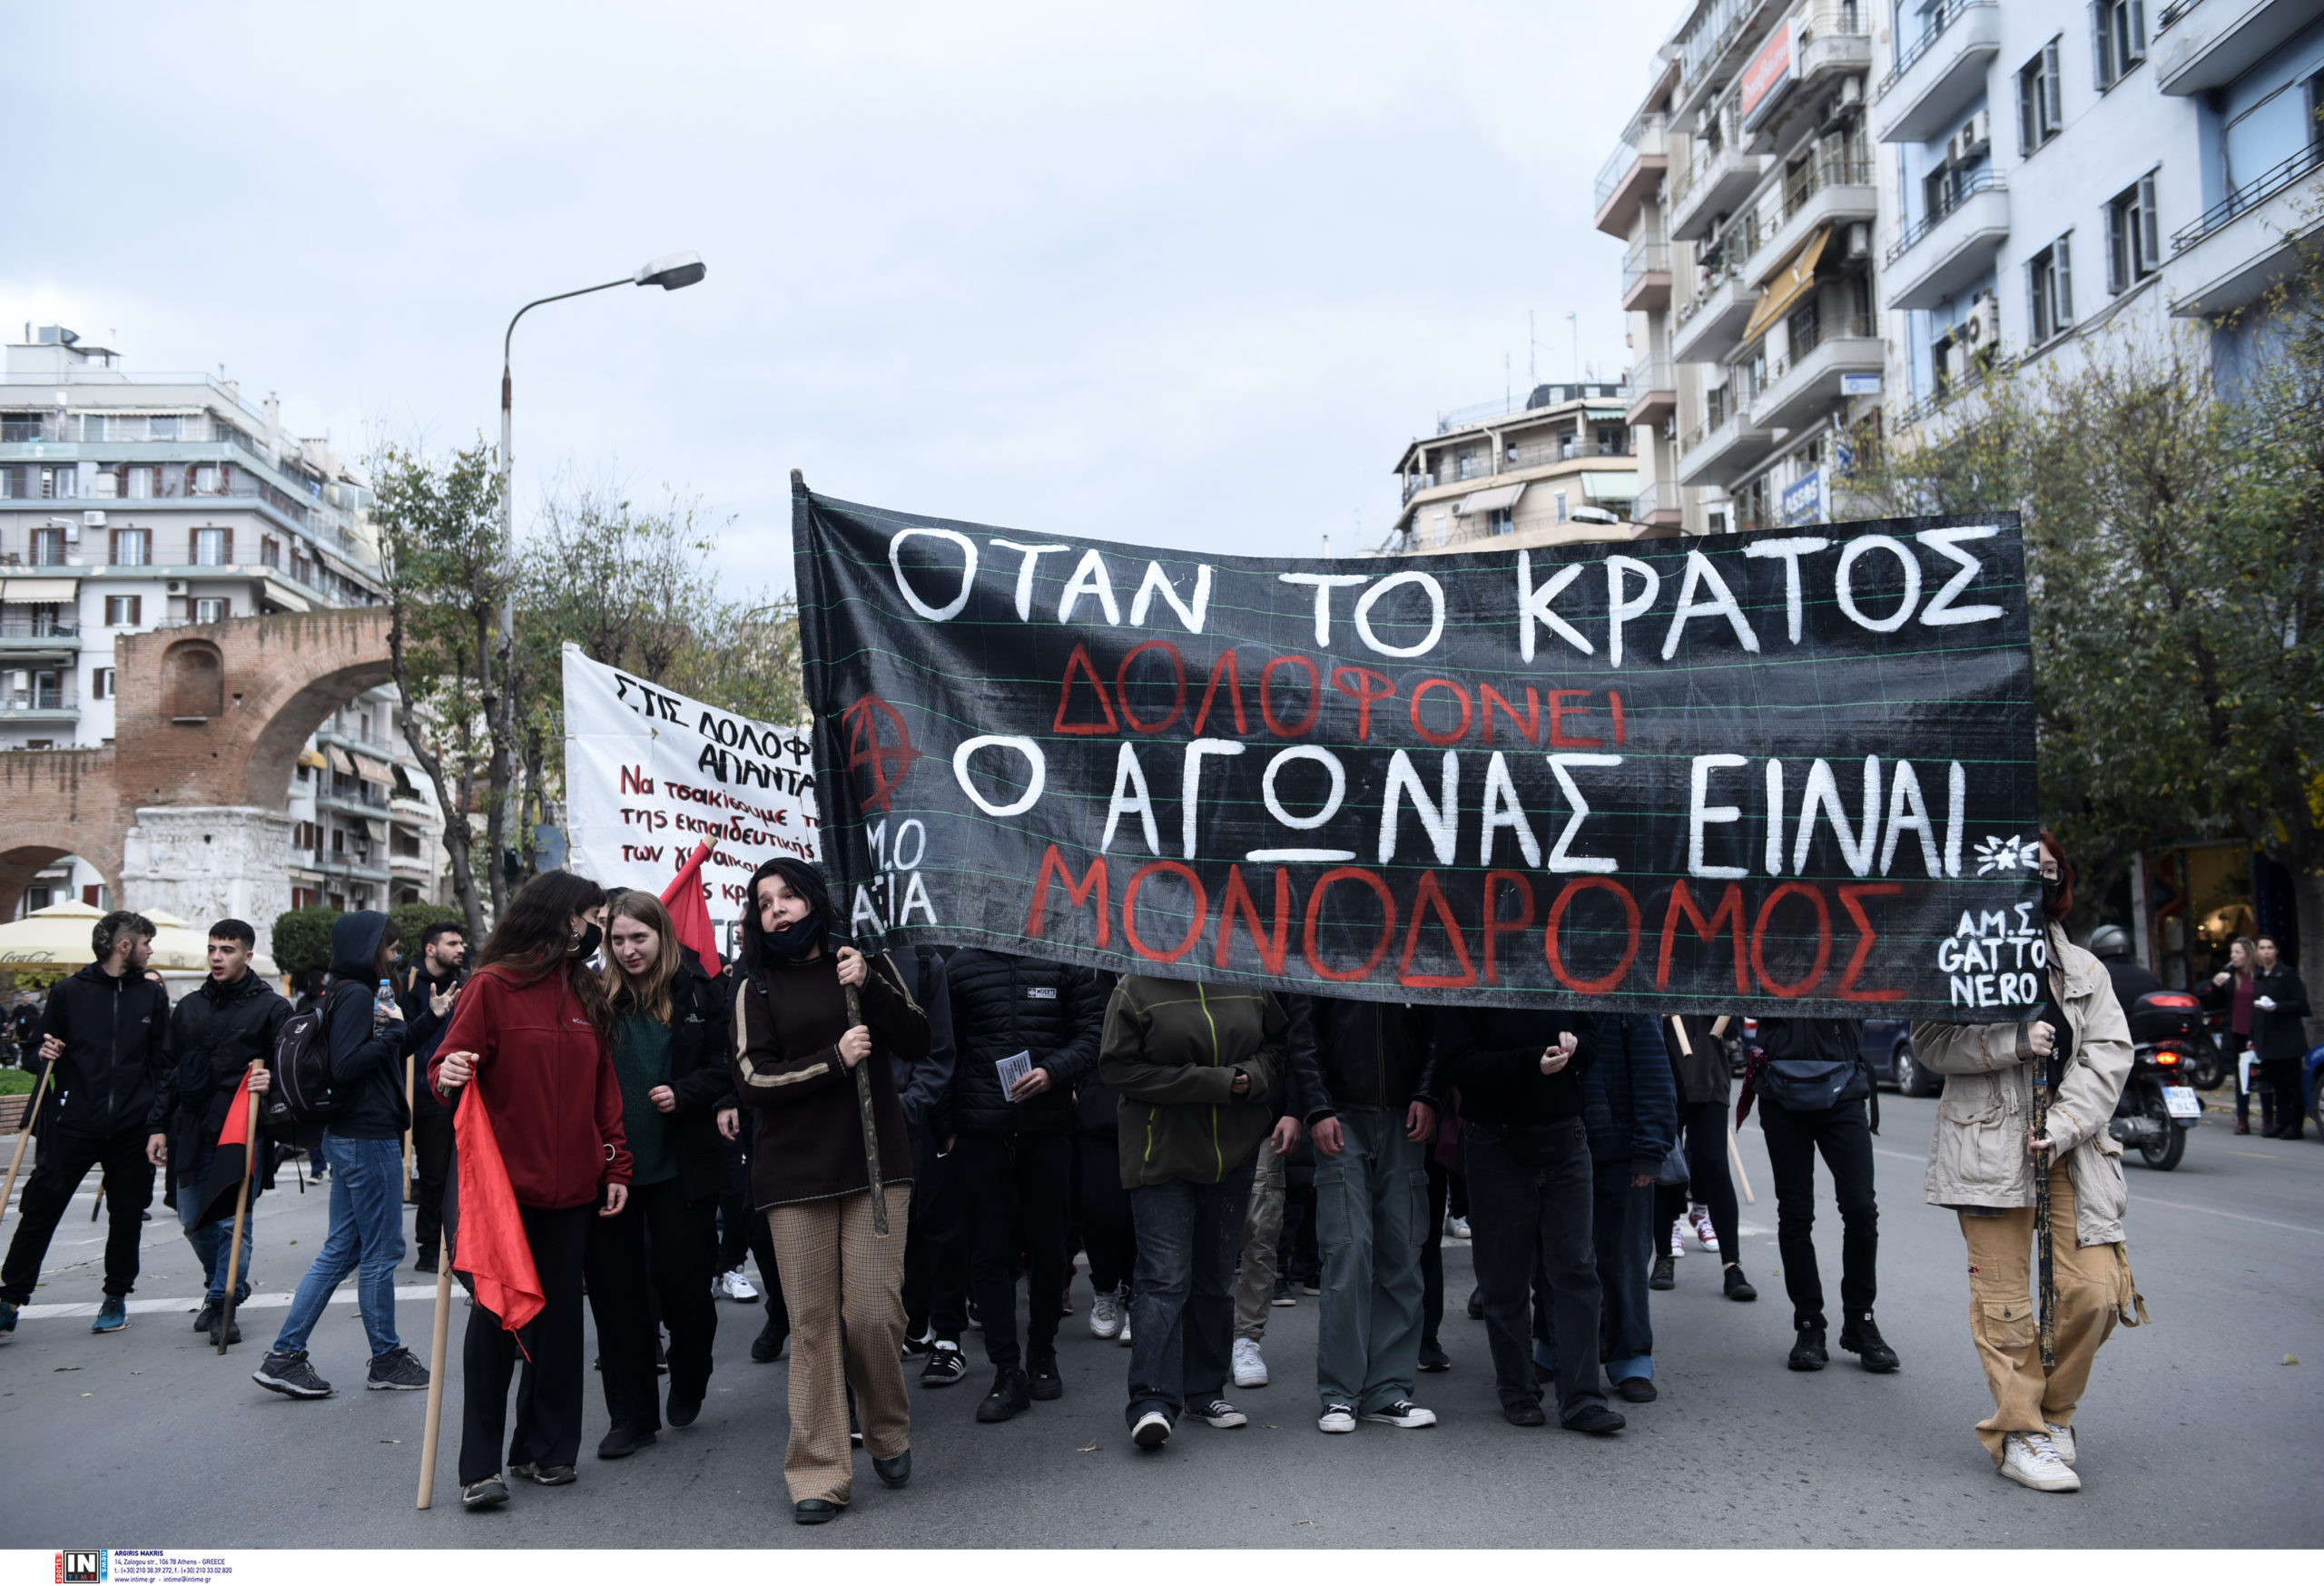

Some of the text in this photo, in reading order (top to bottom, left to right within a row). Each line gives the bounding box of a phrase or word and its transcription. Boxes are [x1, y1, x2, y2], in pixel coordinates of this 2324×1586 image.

[889, 524, 2005, 667] ΟΤΑΝ ΤΟ ΚΡΑΤΟΣ
[615, 674, 690, 727] ΣΤΙΣ
[1054, 640, 1625, 747] ΔΟΛΟΦΟΝΕΙ
[620, 764, 655, 795] Να
[620, 808, 668, 833] της
[953, 734, 1966, 879] Ο ΑΓΩΝΑΣ ΕΙΝΑΙ
[621, 844, 665, 863] των
[1026, 844, 1906, 1001] ΜΟΝΟΔΡΟΜΟΣ
[1937, 936, 2047, 974] GATTO
[1950, 972, 2038, 1008] NERO
